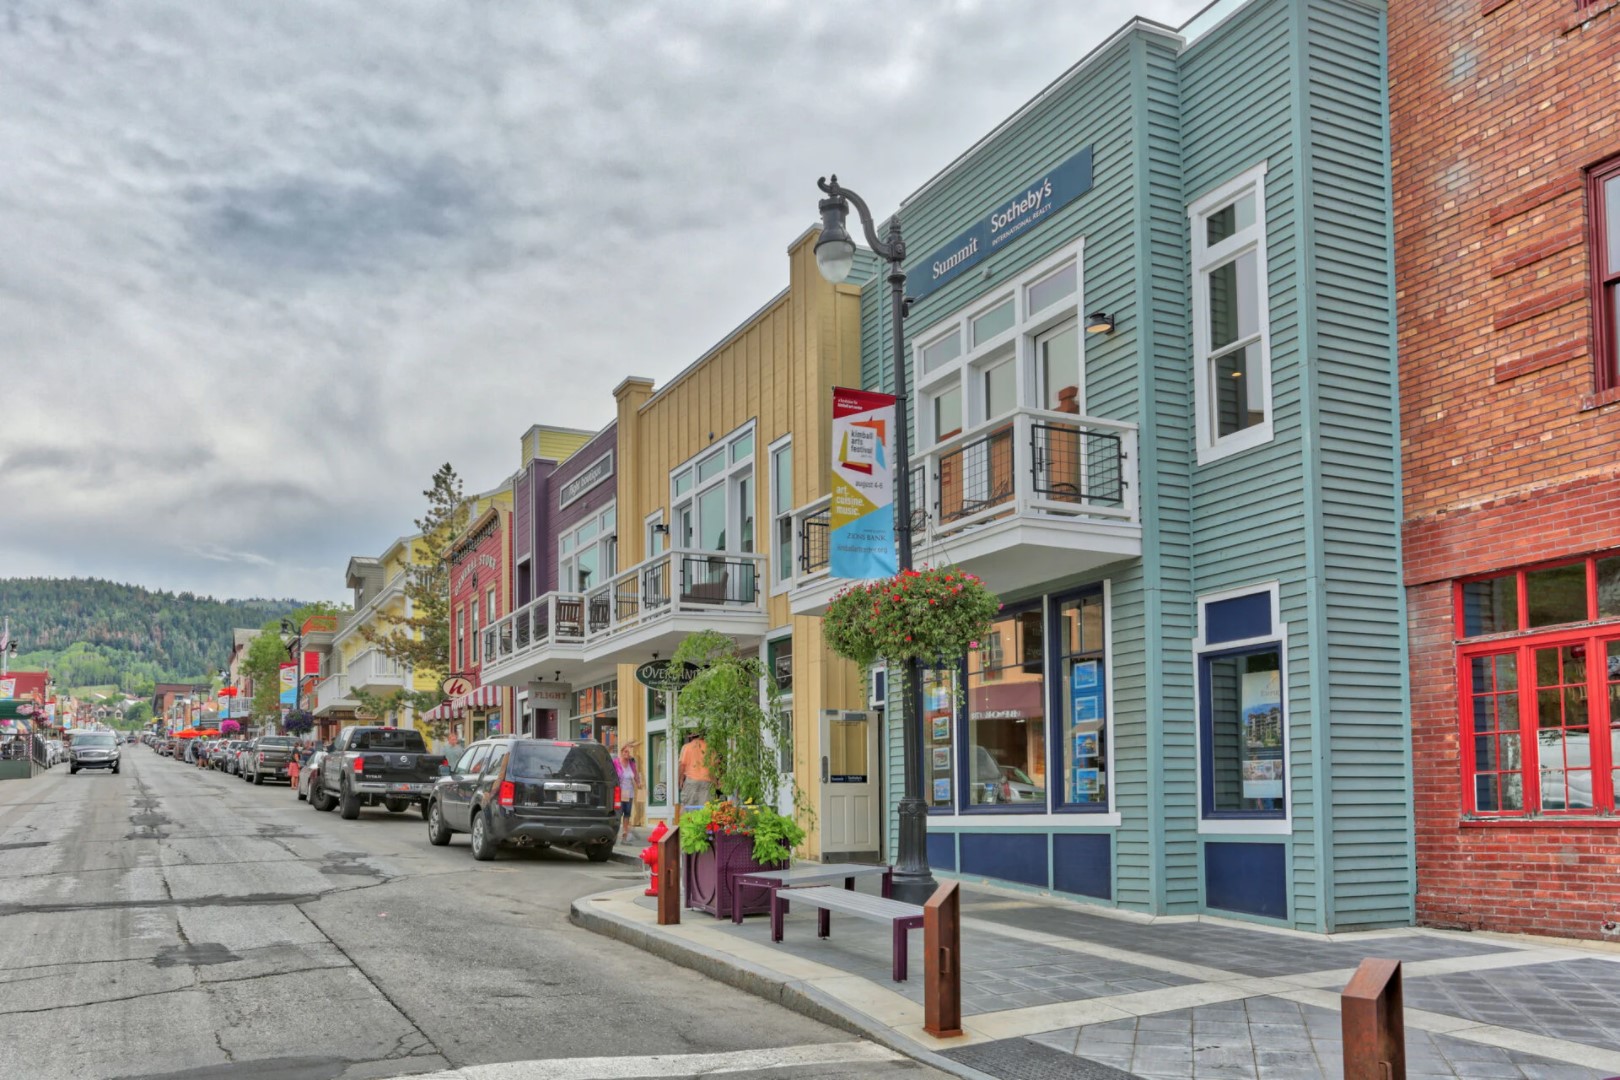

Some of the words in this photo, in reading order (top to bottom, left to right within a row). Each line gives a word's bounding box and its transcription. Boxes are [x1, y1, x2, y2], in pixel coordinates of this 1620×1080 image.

[932, 237, 978, 279] Summit
[990, 178, 1052, 233] Sotheby's
[991, 216, 1032, 246] INTERNATIONAL
[1032, 202, 1052, 220] REALTY
[851, 429, 873, 439] kimball
[851, 445, 873, 454] festival
[855, 481, 873, 489] august
[836, 486, 849, 495] art.
[836, 495, 864, 507] cuisine.
[836, 505, 860, 516] music.
[847, 532, 866, 541] ZIONS
[866, 533, 886, 541] BANK
[454, 556, 477, 596] GENERAL
[479, 554, 497, 570] STORE
[534, 691, 567, 700] FLIGHT
